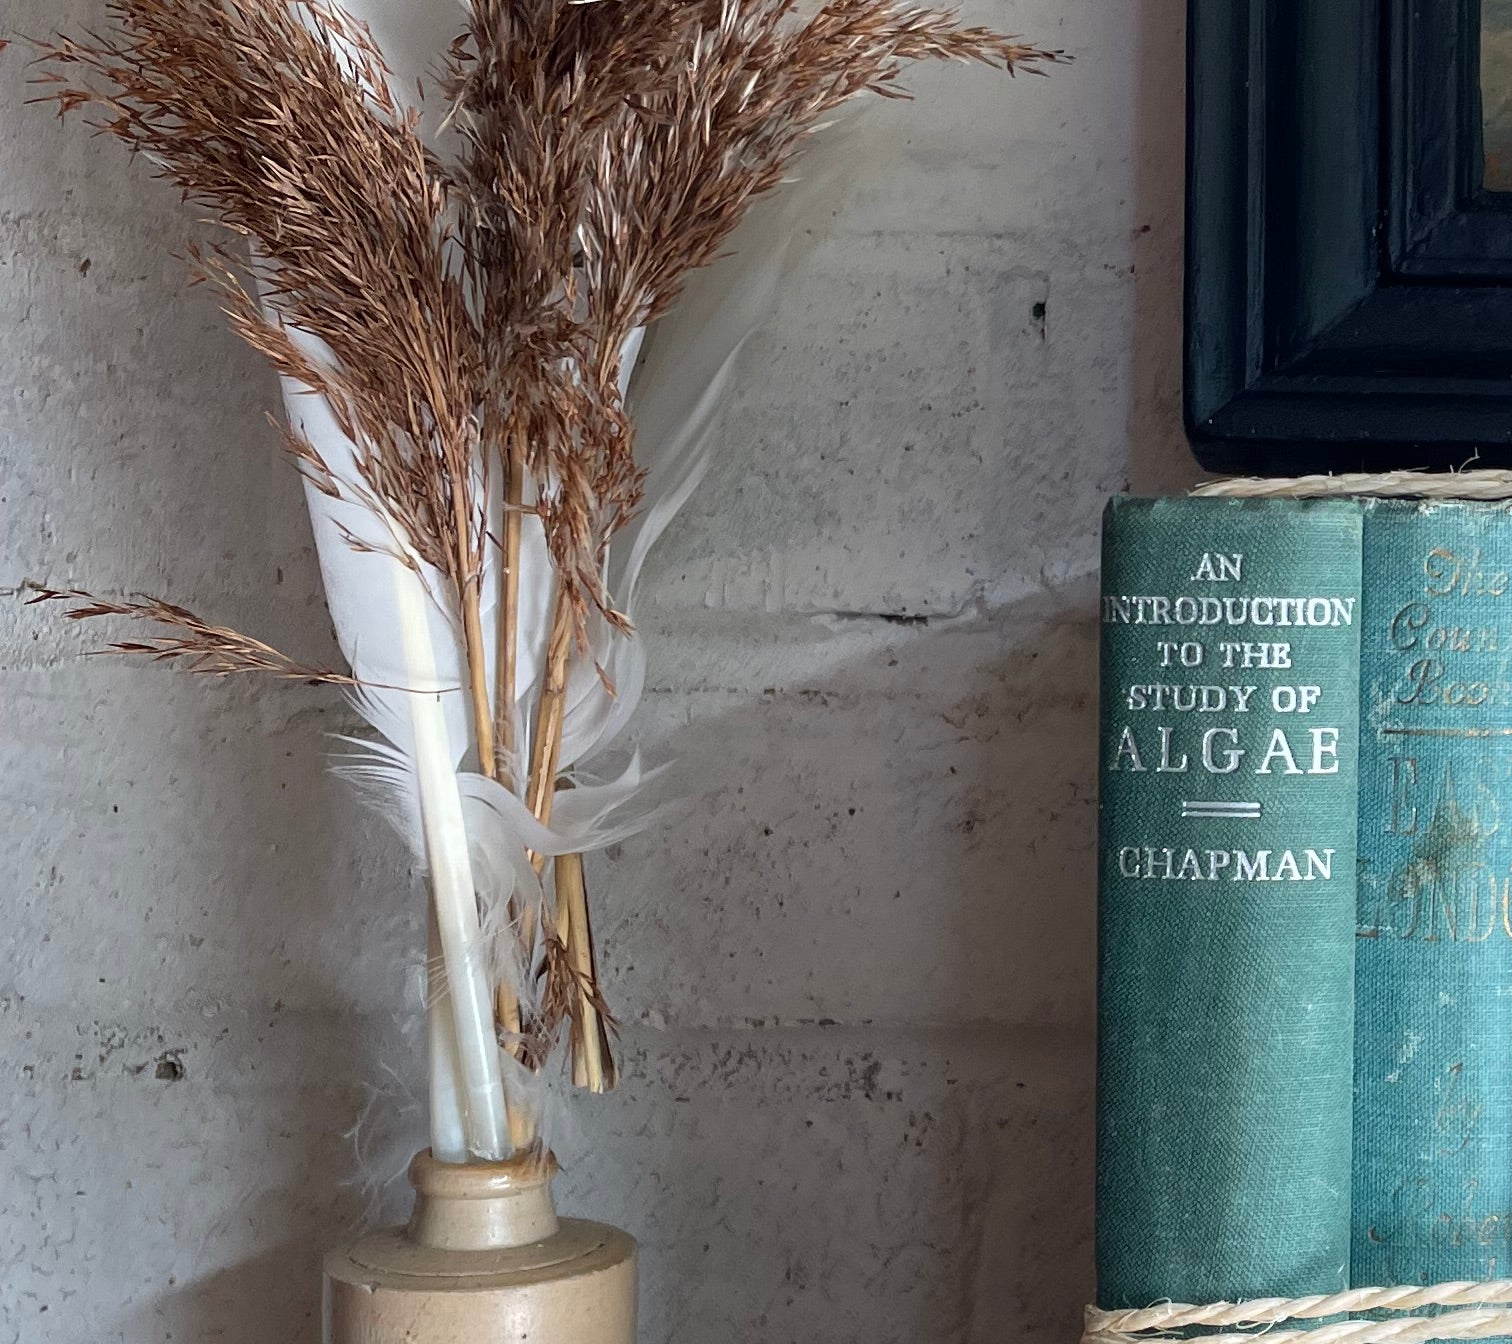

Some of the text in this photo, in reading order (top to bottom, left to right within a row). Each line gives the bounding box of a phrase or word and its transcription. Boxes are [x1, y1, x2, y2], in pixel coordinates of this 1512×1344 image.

[1191, 552, 1243, 582] AN
[1102, 595, 1356, 626] INTRODUCTION
[1157, 641, 1292, 669] TO THE
[1127, 684, 1321, 712] STUDY OF
[1109, 725, 1340, 775] ALGAE
[1118, 846, 1335, 882] CHAPMAN
